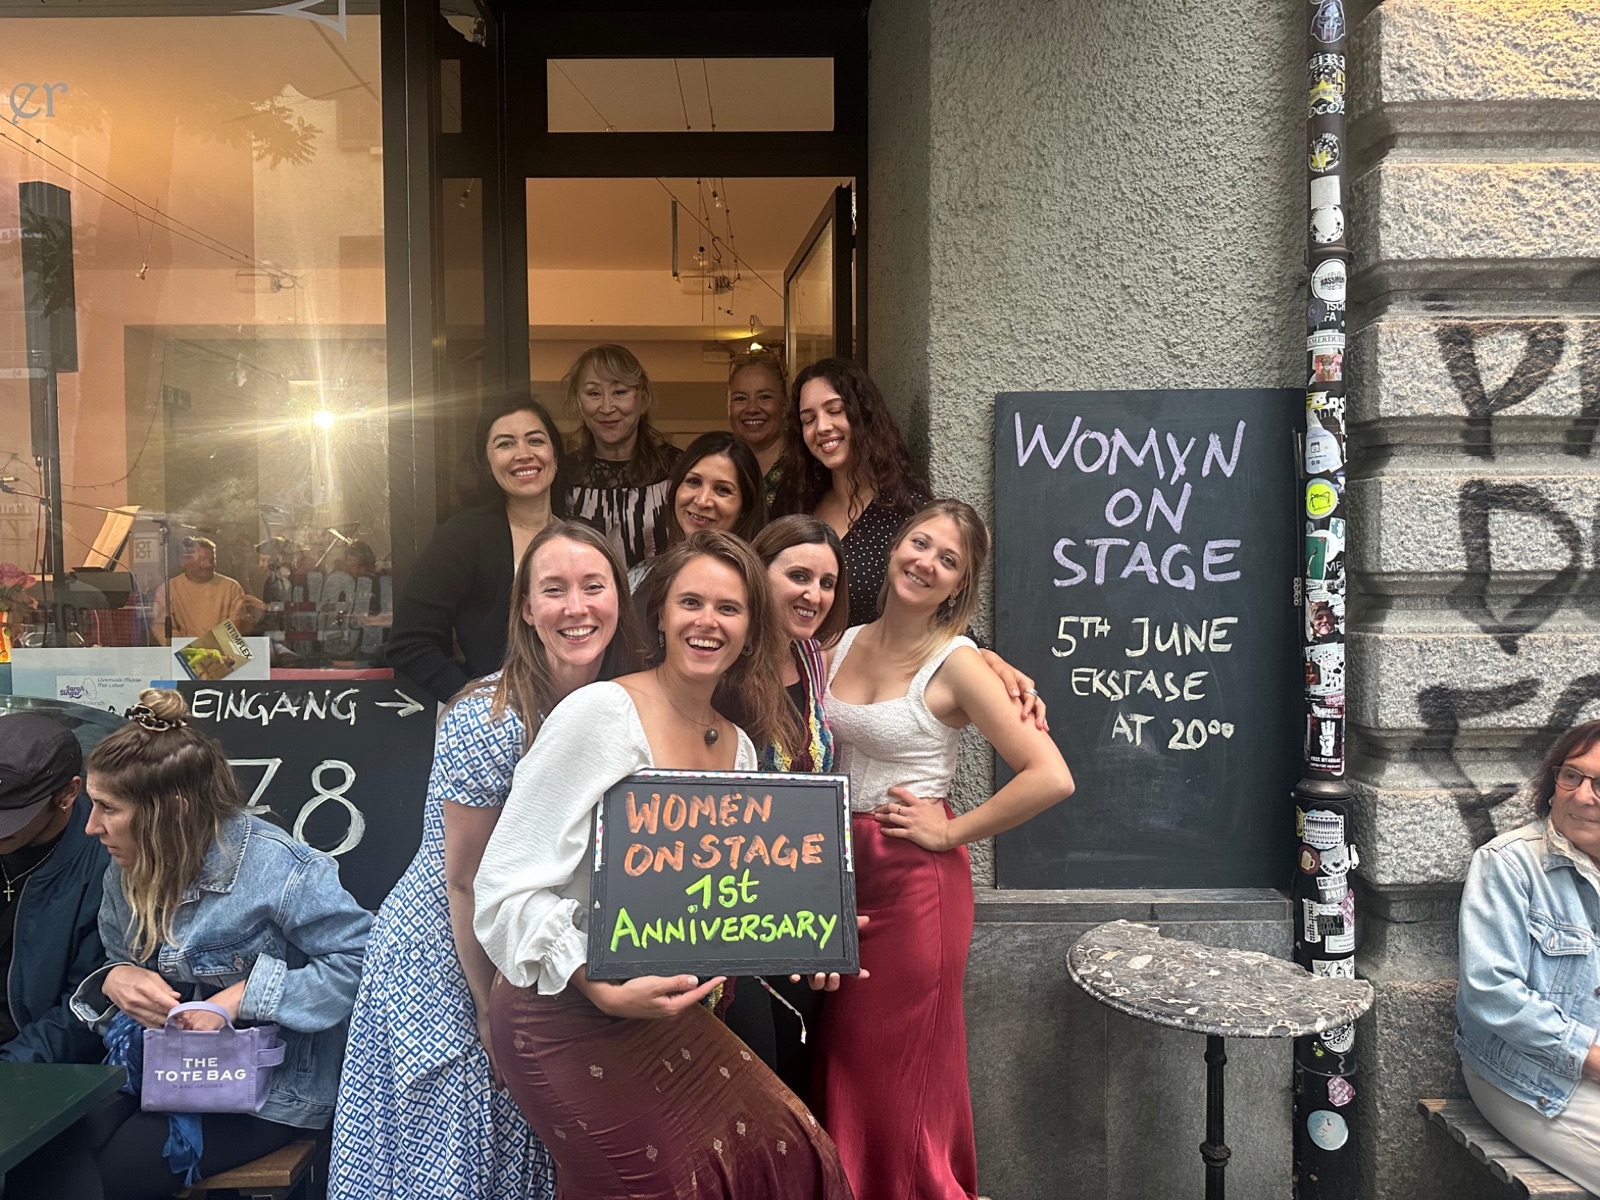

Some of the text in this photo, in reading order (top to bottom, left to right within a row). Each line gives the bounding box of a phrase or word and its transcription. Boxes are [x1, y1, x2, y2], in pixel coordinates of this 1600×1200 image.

[1014, 412, 1246, 484] WOMYN
[1105, 482, 1192, 534] ON
[1052, 538, 1241, 590] STAGE
[224, 621, 253, 660] INTIMFLEX
[1051, 616, 1239, 658] 5TH JUNE
[1071, 668, 1209, 701] EKSTASE
[192, 689, 359, 726] EINGANG
[1111, 713, 1155, 746] AT
[625, 791, 772, 835] WOMEN
[624, 832, 825, 877] ON STAGE
[155, 1069, 247, 1082] TOTE BAG
[182, 1057, 218, 1068] THE
